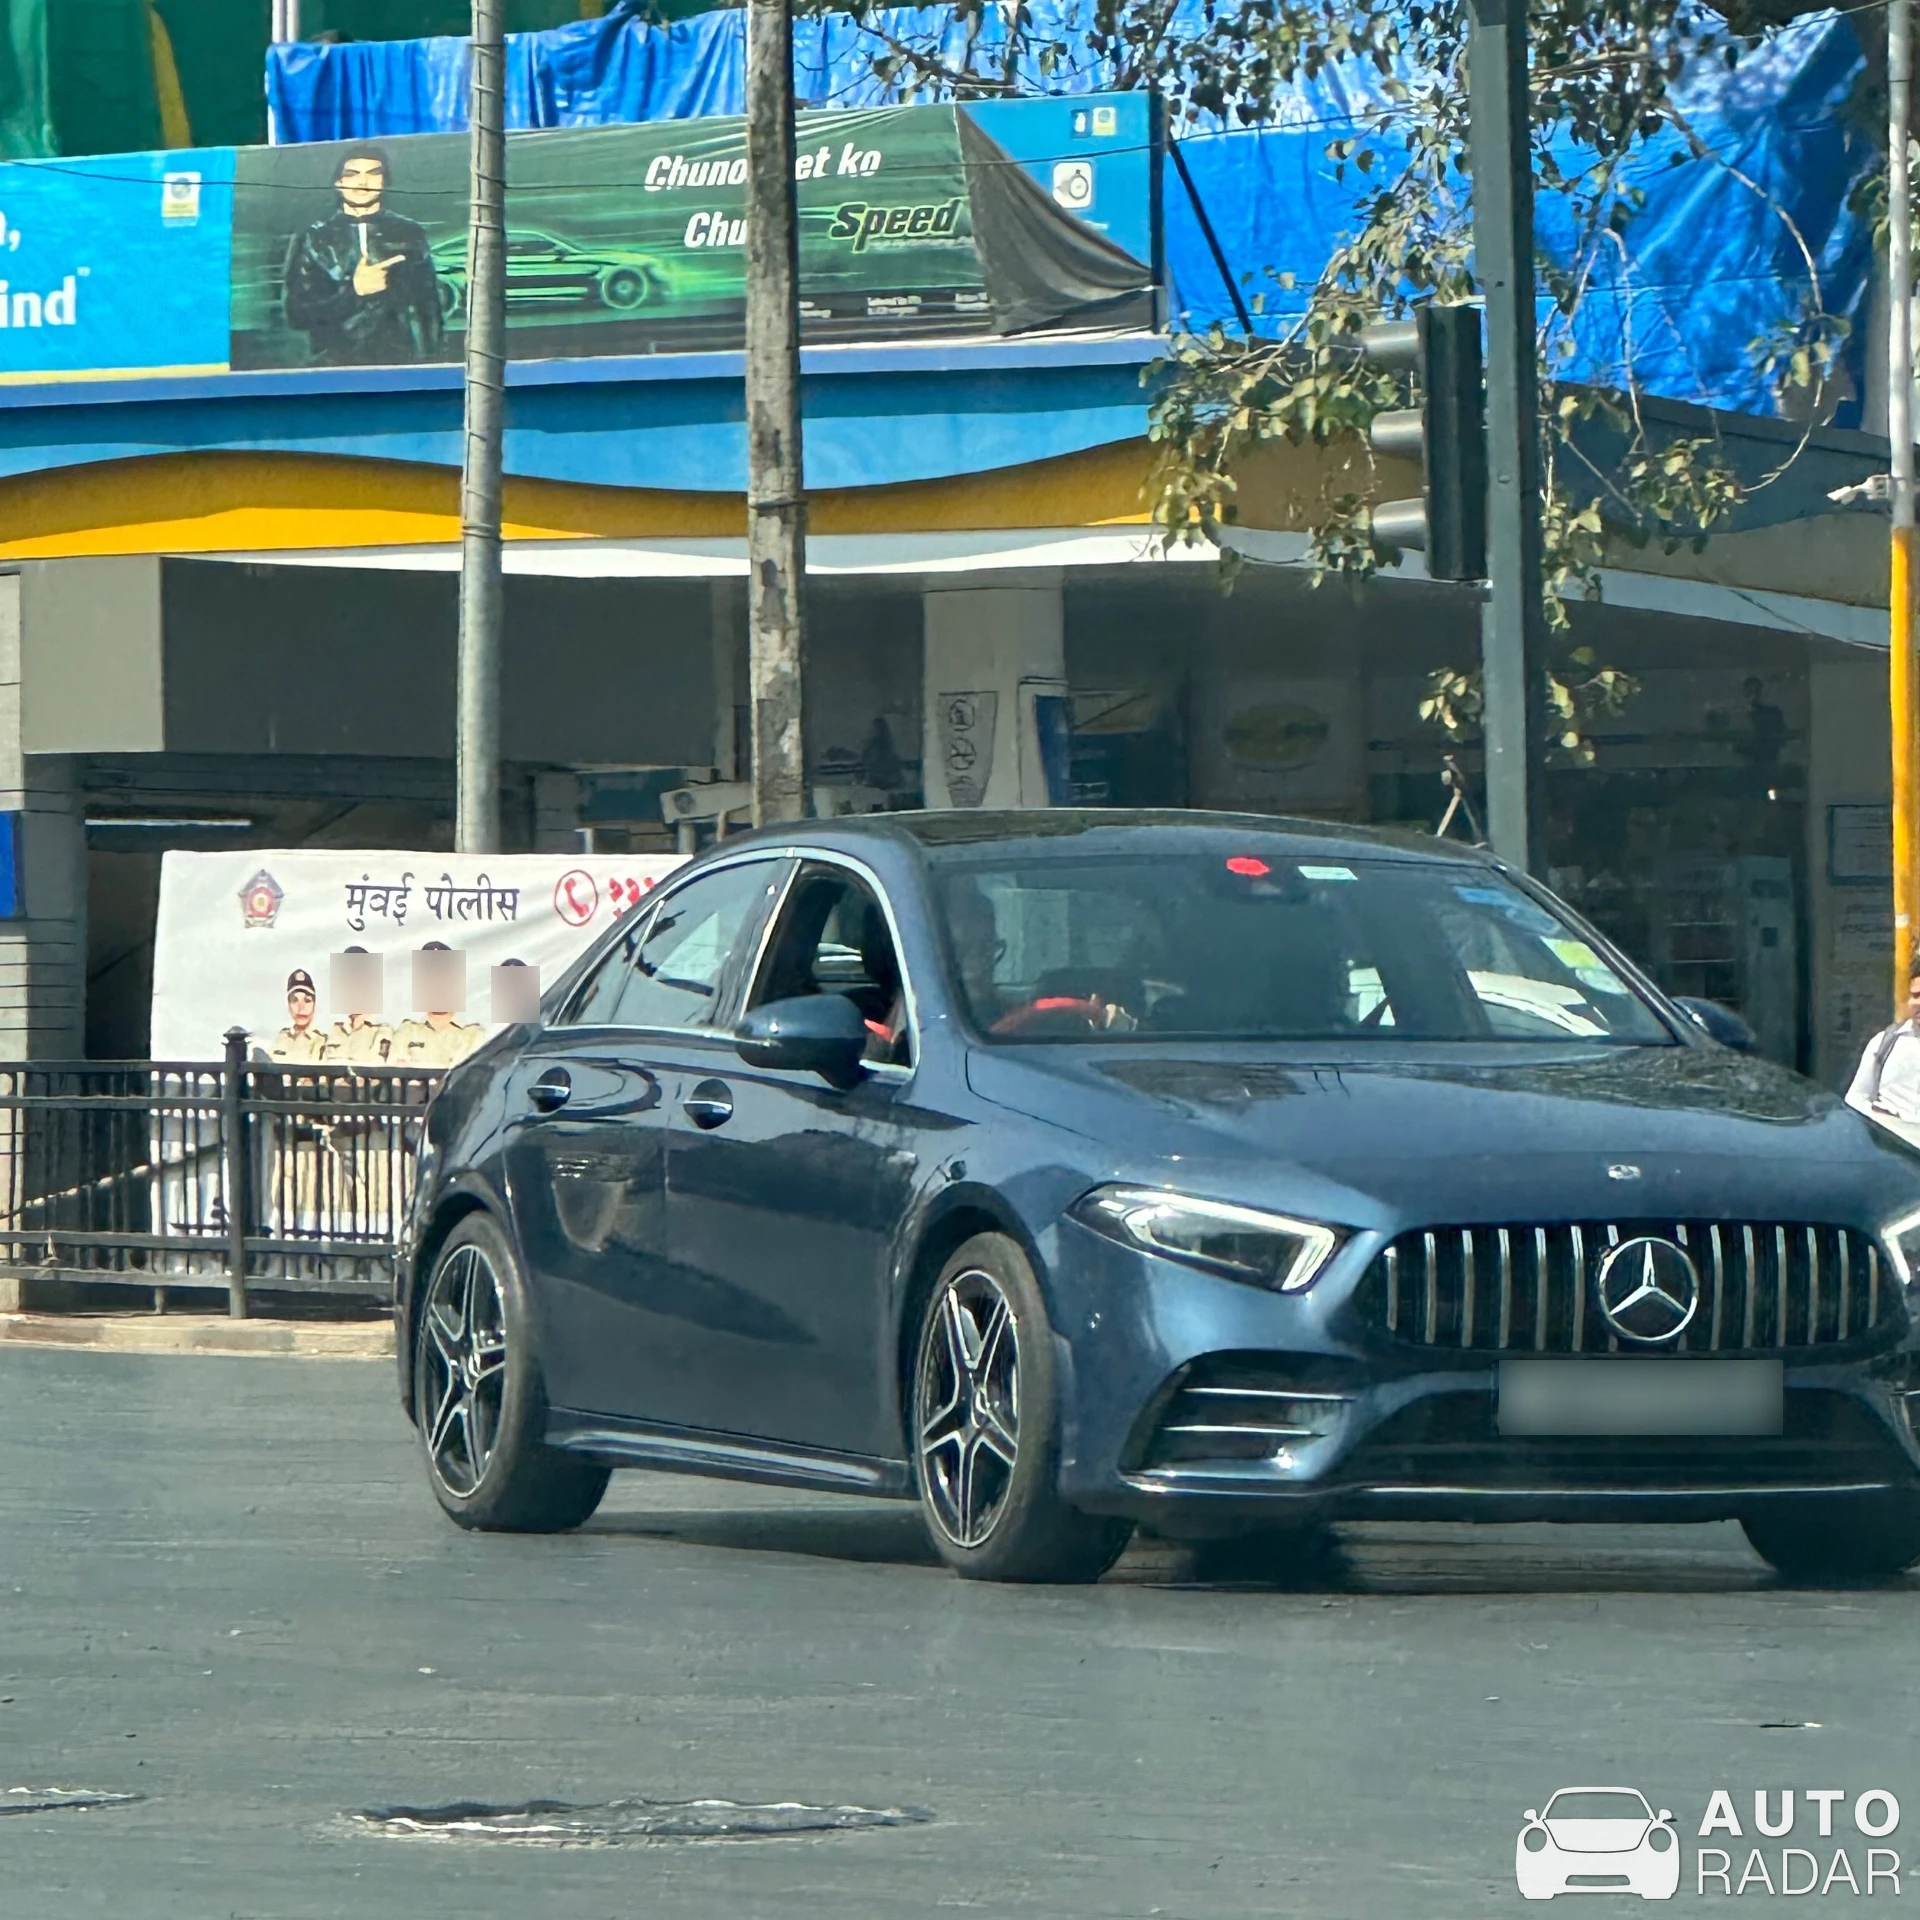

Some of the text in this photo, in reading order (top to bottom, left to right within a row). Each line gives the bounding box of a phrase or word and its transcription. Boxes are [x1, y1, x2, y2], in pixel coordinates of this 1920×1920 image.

[796, 146, 831, 180] et
[837, 143, 882, 177] ko
[684, 197, 966, 254] Chu Speed
[345, 872, 520, 931] मुंबई पोलीस
